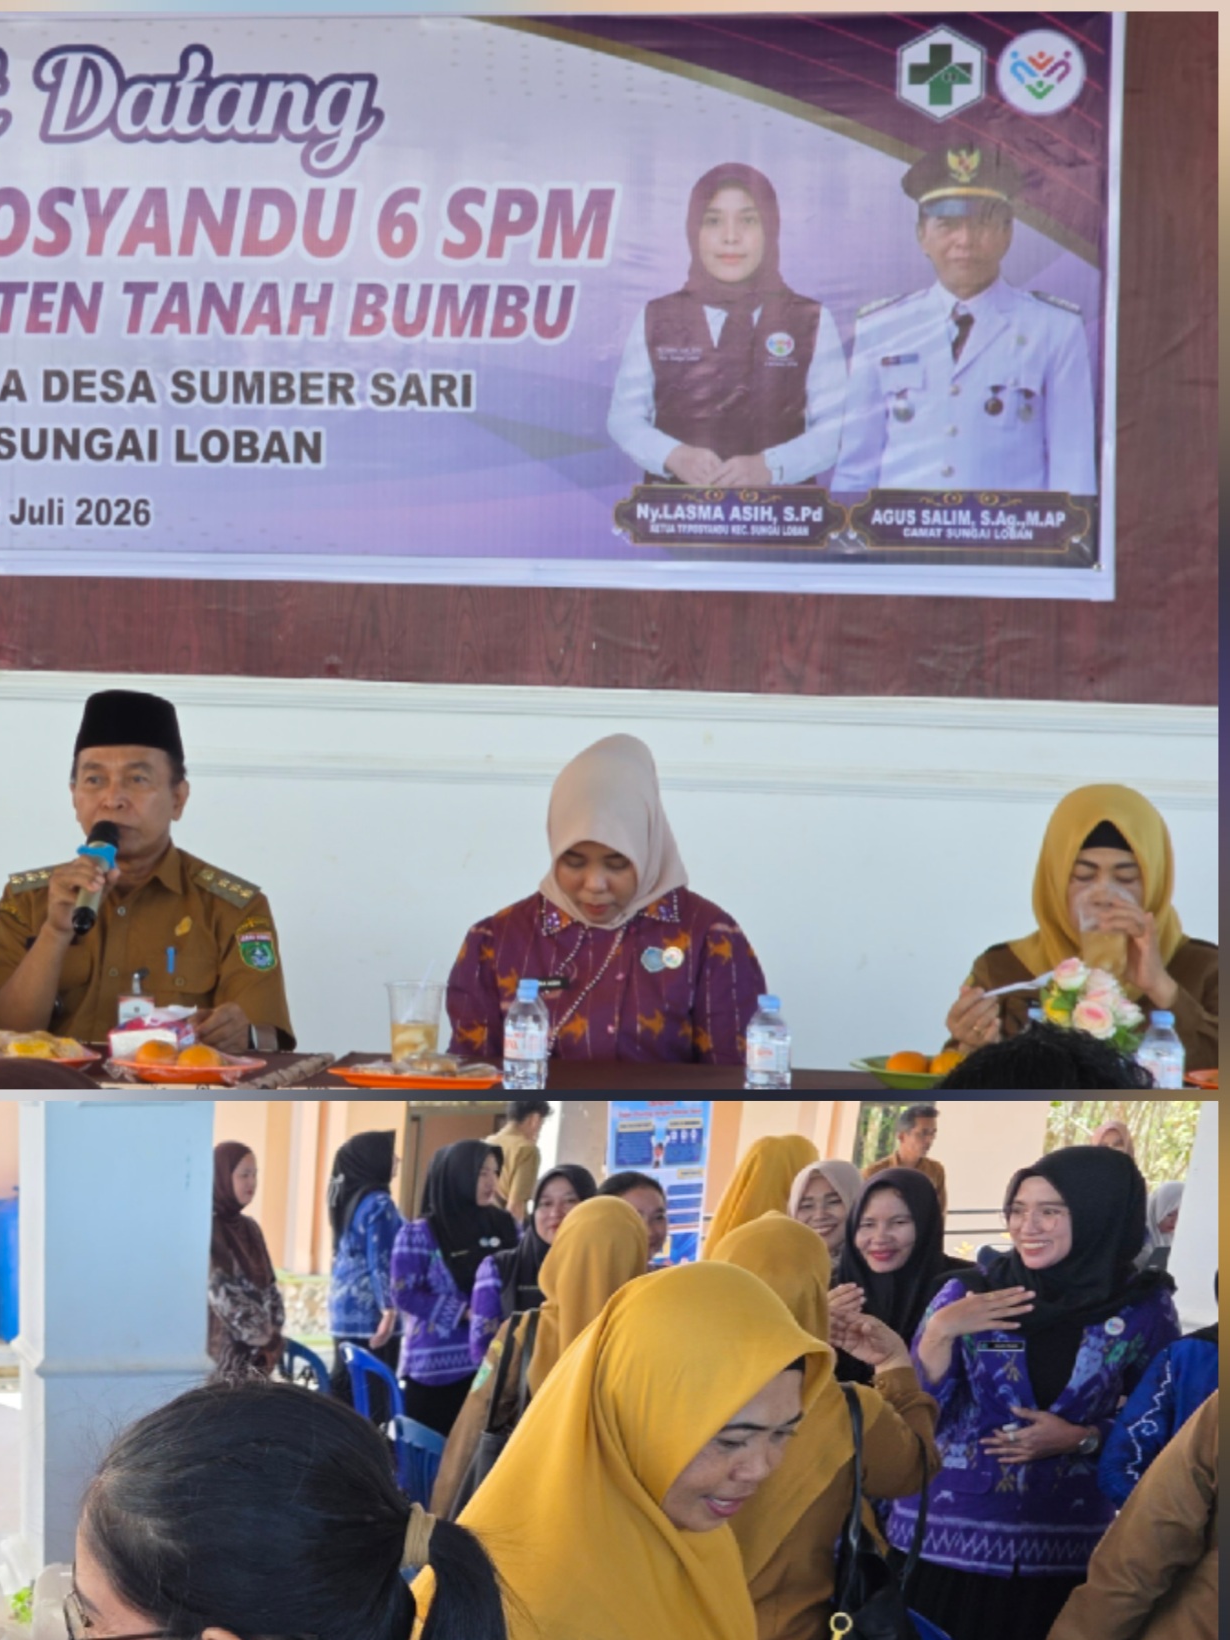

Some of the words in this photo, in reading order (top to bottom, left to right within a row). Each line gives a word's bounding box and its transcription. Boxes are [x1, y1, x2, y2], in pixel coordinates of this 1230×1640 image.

[32, 43, 384, 178] Datang
[377, 186, 421, 258] 6
[441, 186, 616, 260] SPM
[121, 281, 335, 335] TANAH
[347, 283, 576, 338] BUMBU
[42, 368, 157, 403] DESA
[170, 369, 355, 405] SUMBER
[370, 371, 473, 408] SARI
[174, 428, 323, 464] LOBAN
[8, 495, 65, 527] Juli
[74, 497, 151, 527] 2026
[729, 505, 778, 524] ASIH,
[783, 506, 823, 522] S.Pd
[871, 509, 916, 525] AGUS
